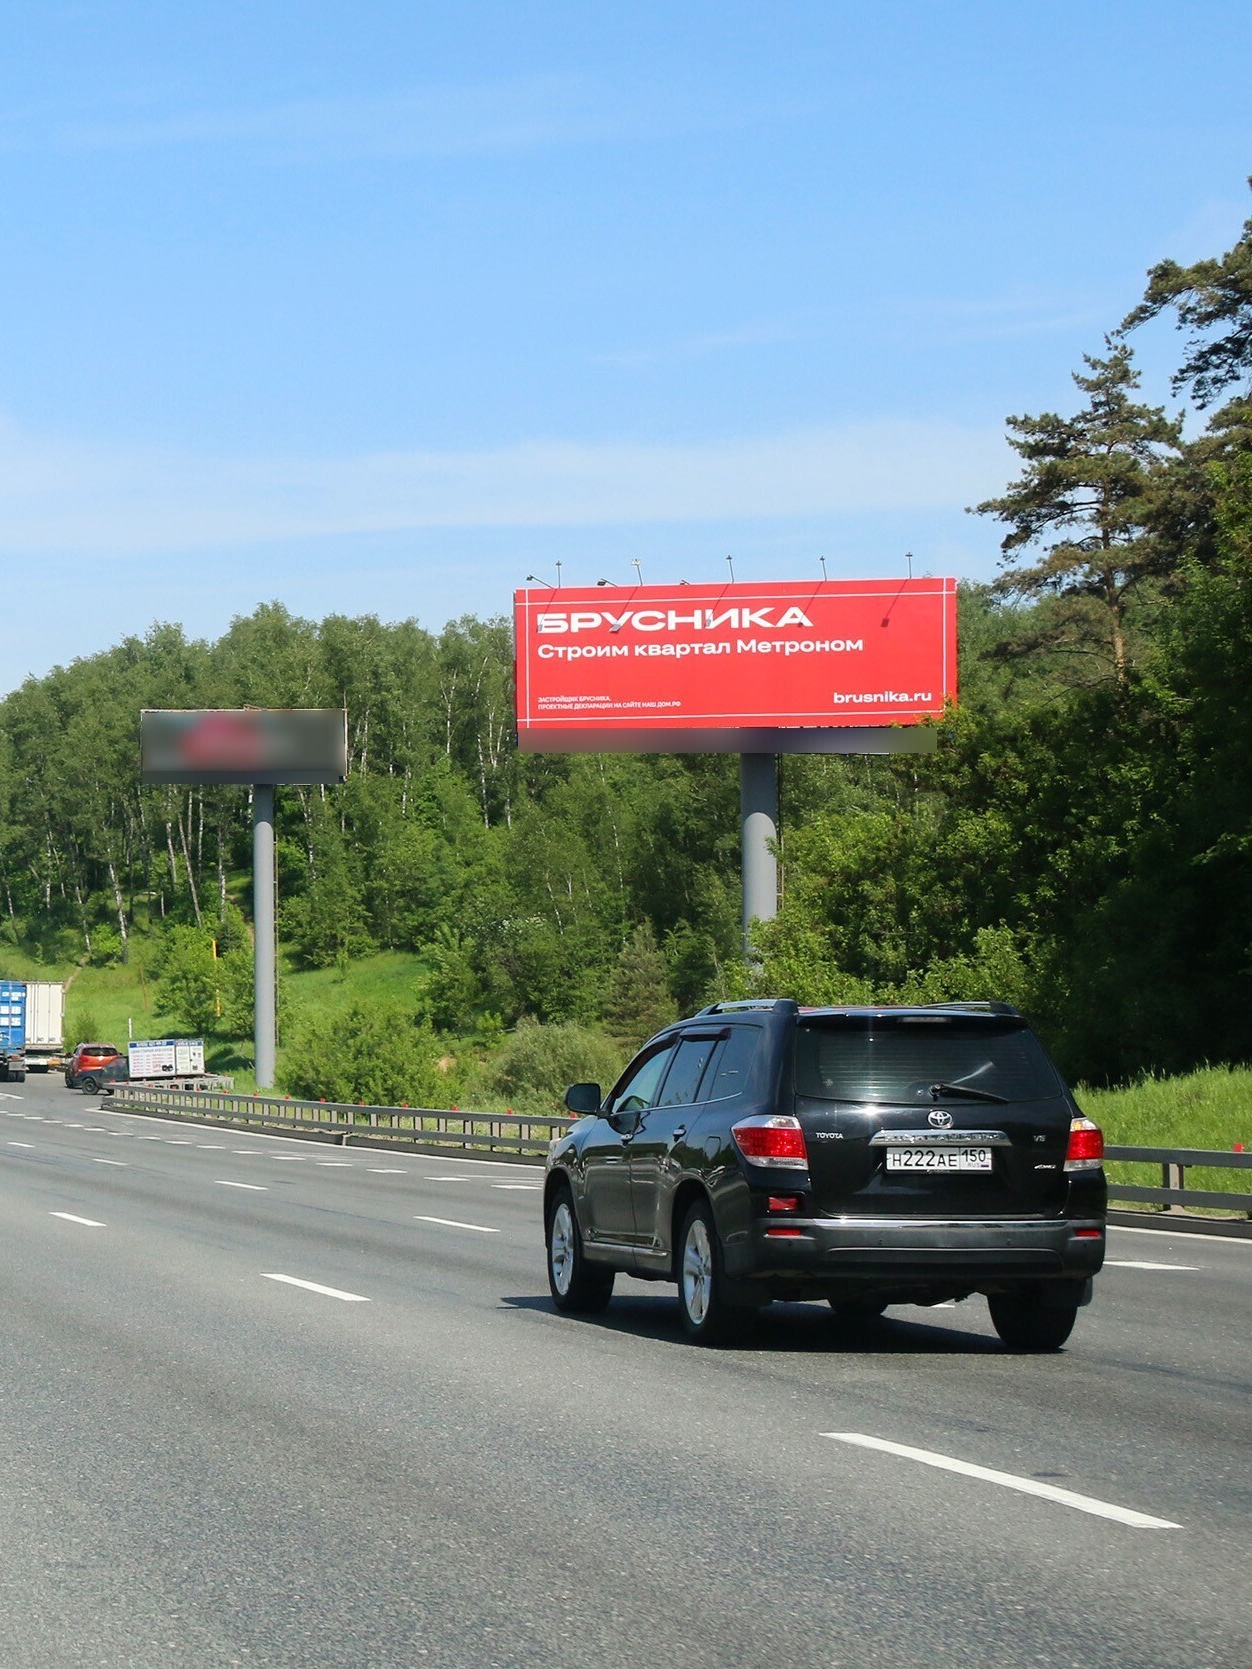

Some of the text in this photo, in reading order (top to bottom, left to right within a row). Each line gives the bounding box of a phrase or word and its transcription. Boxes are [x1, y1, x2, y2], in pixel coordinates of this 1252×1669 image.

[537, 606, 814, 634] БРУСНИКА
[537, 639, 864, 661] Строим квартал Метроном
[833, 690, 932, 704] brusnika.ru
[961, 1149, 986, 1163] 150
